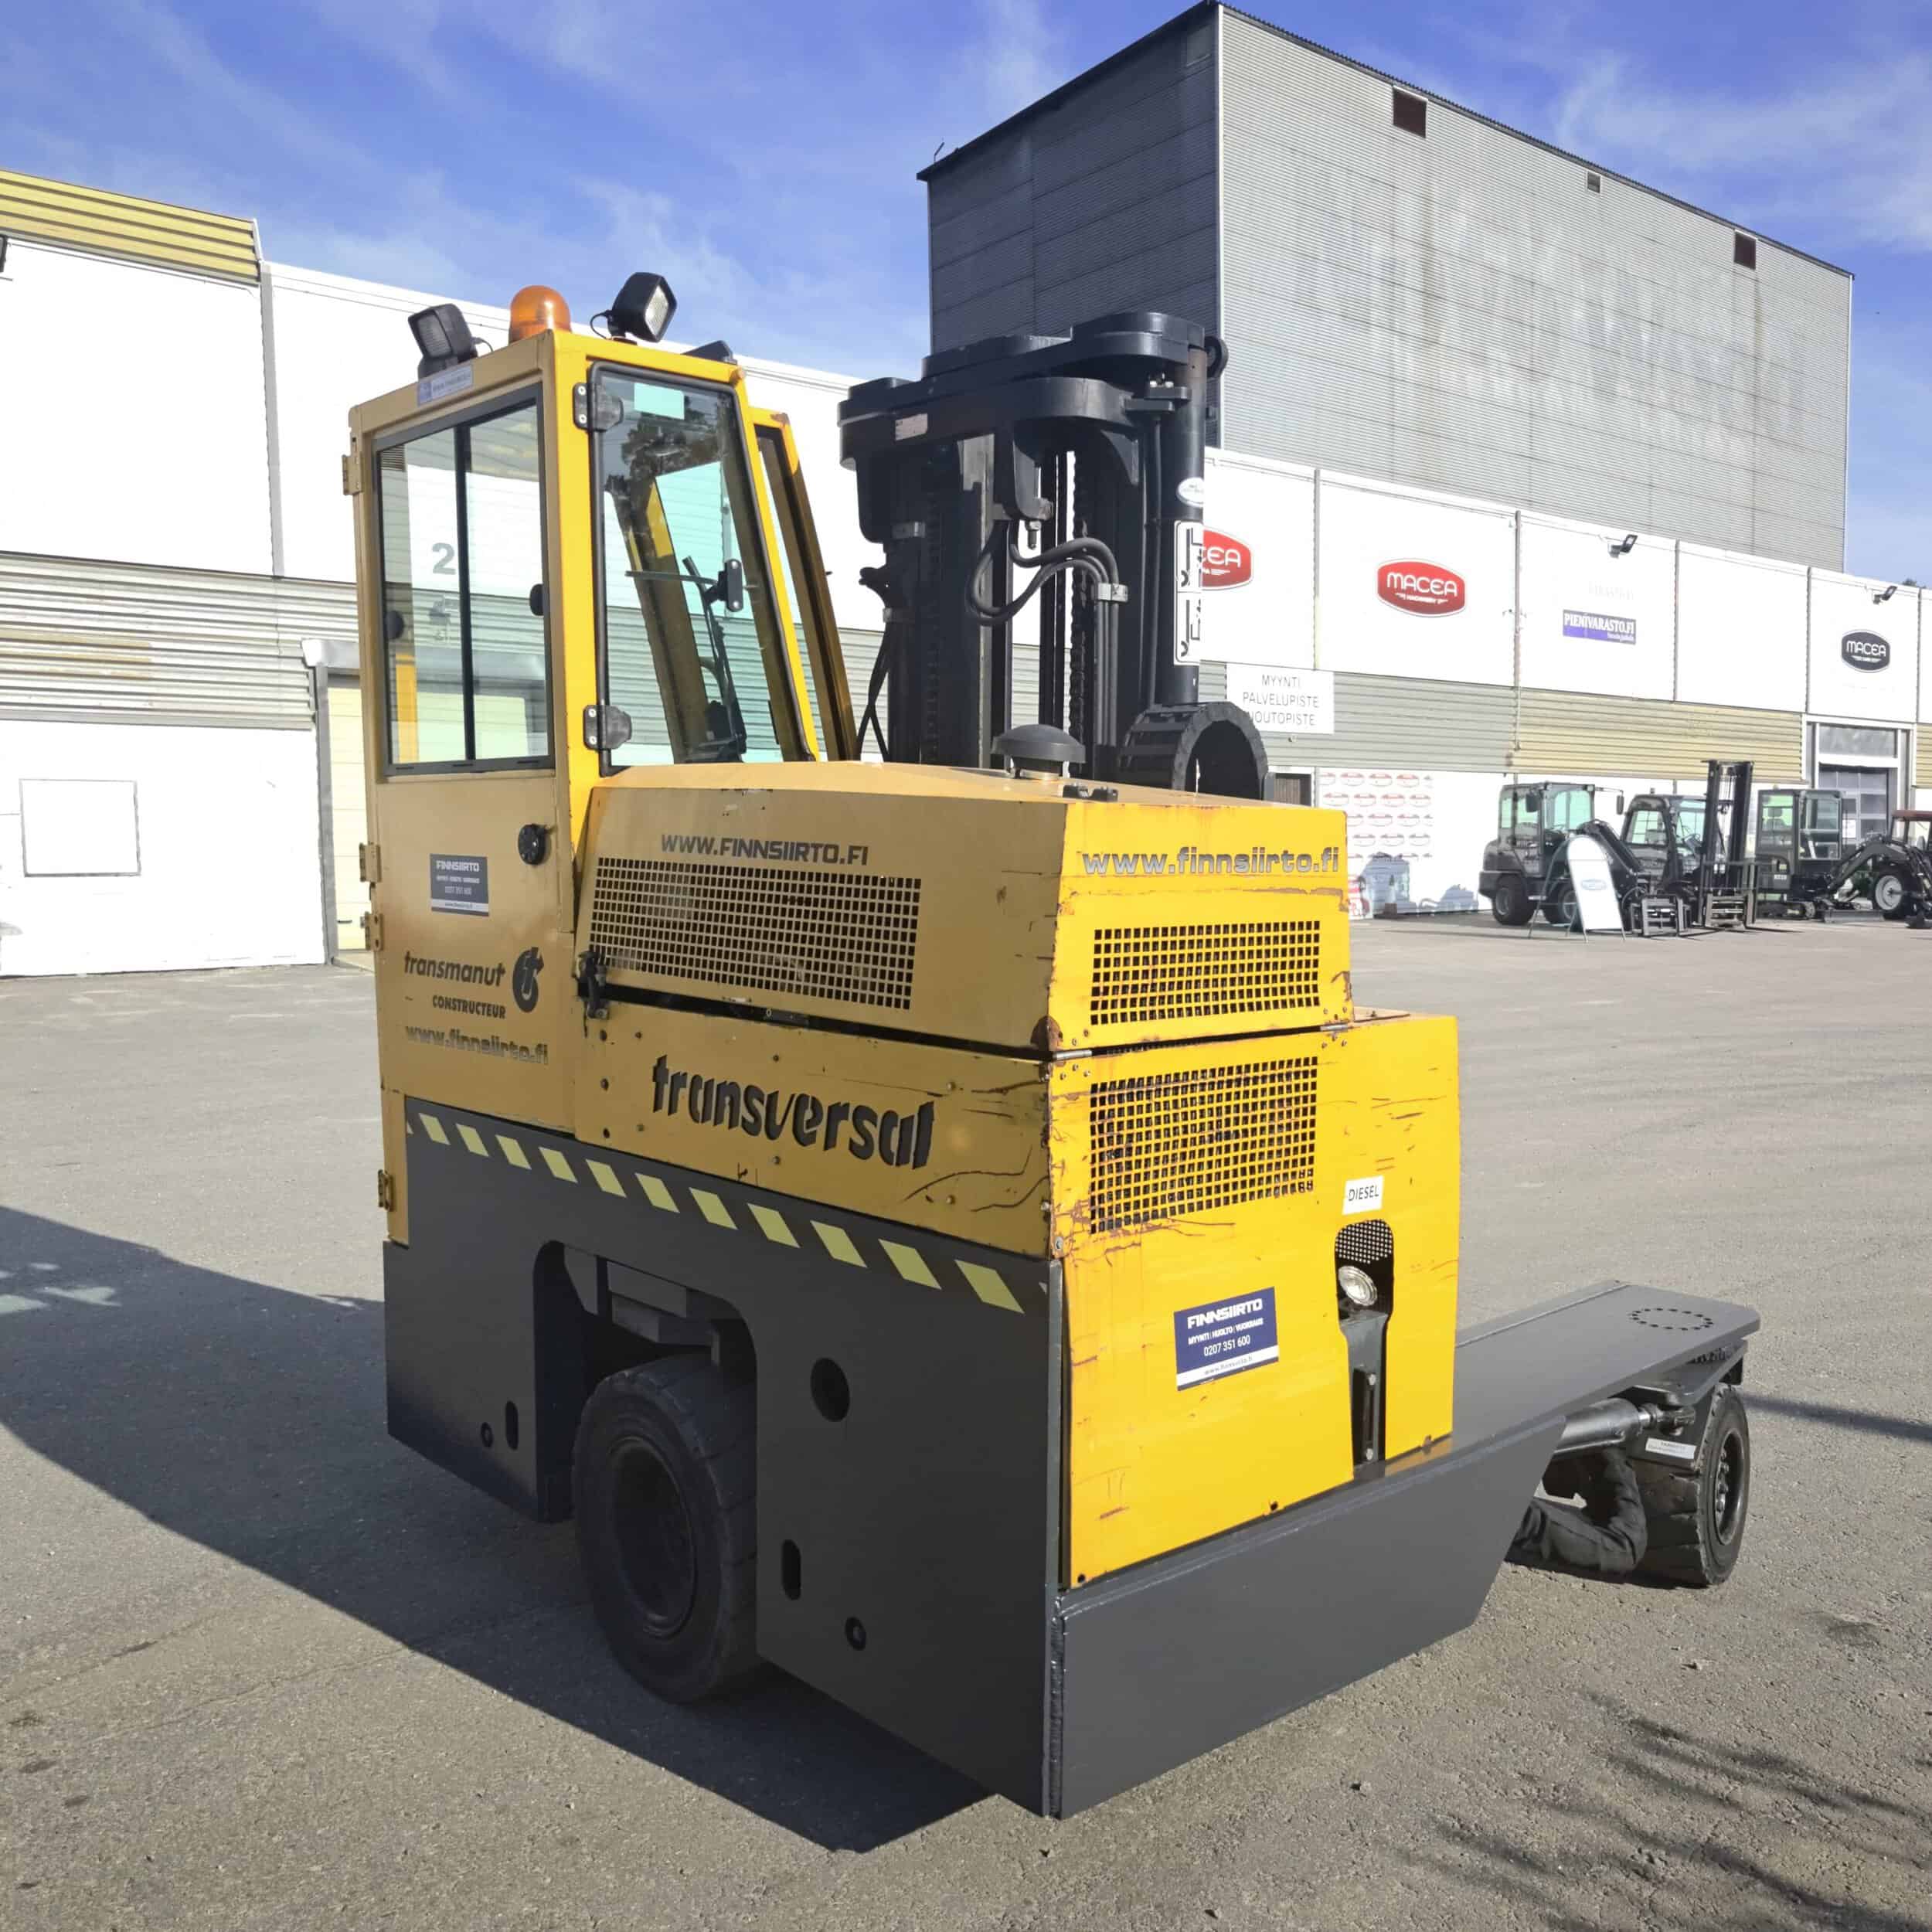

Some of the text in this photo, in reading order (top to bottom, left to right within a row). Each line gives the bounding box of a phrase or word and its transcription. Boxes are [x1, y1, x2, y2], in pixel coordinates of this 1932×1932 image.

[432, 543, 456, 575] 2
[1386, 572, 1458, 597] MACEA
[1846, 640, 1886, 657] MACEA
[1261, 674, 1301, 687] MYYNTI
[1243, 692, 1319, 708] PALVELUPISTE
[661, 834, 869, 866] WWW.FINNSIIRTO.FI
[1081, 846, 1339, 875] www.finnsiirto.fi
[404, 951, 505, 987] transmanut
[432, 995, 506, 1019] CONSTRUCTEUR
[652, 1054, 934, 1170] transversal
[1349, 1185, 1379, 1202] DIESEL
[1187, 1298, 1263, 1328] FINNSIIRTO
[1204, 1335, 1252, 1356] 0207 351 600
